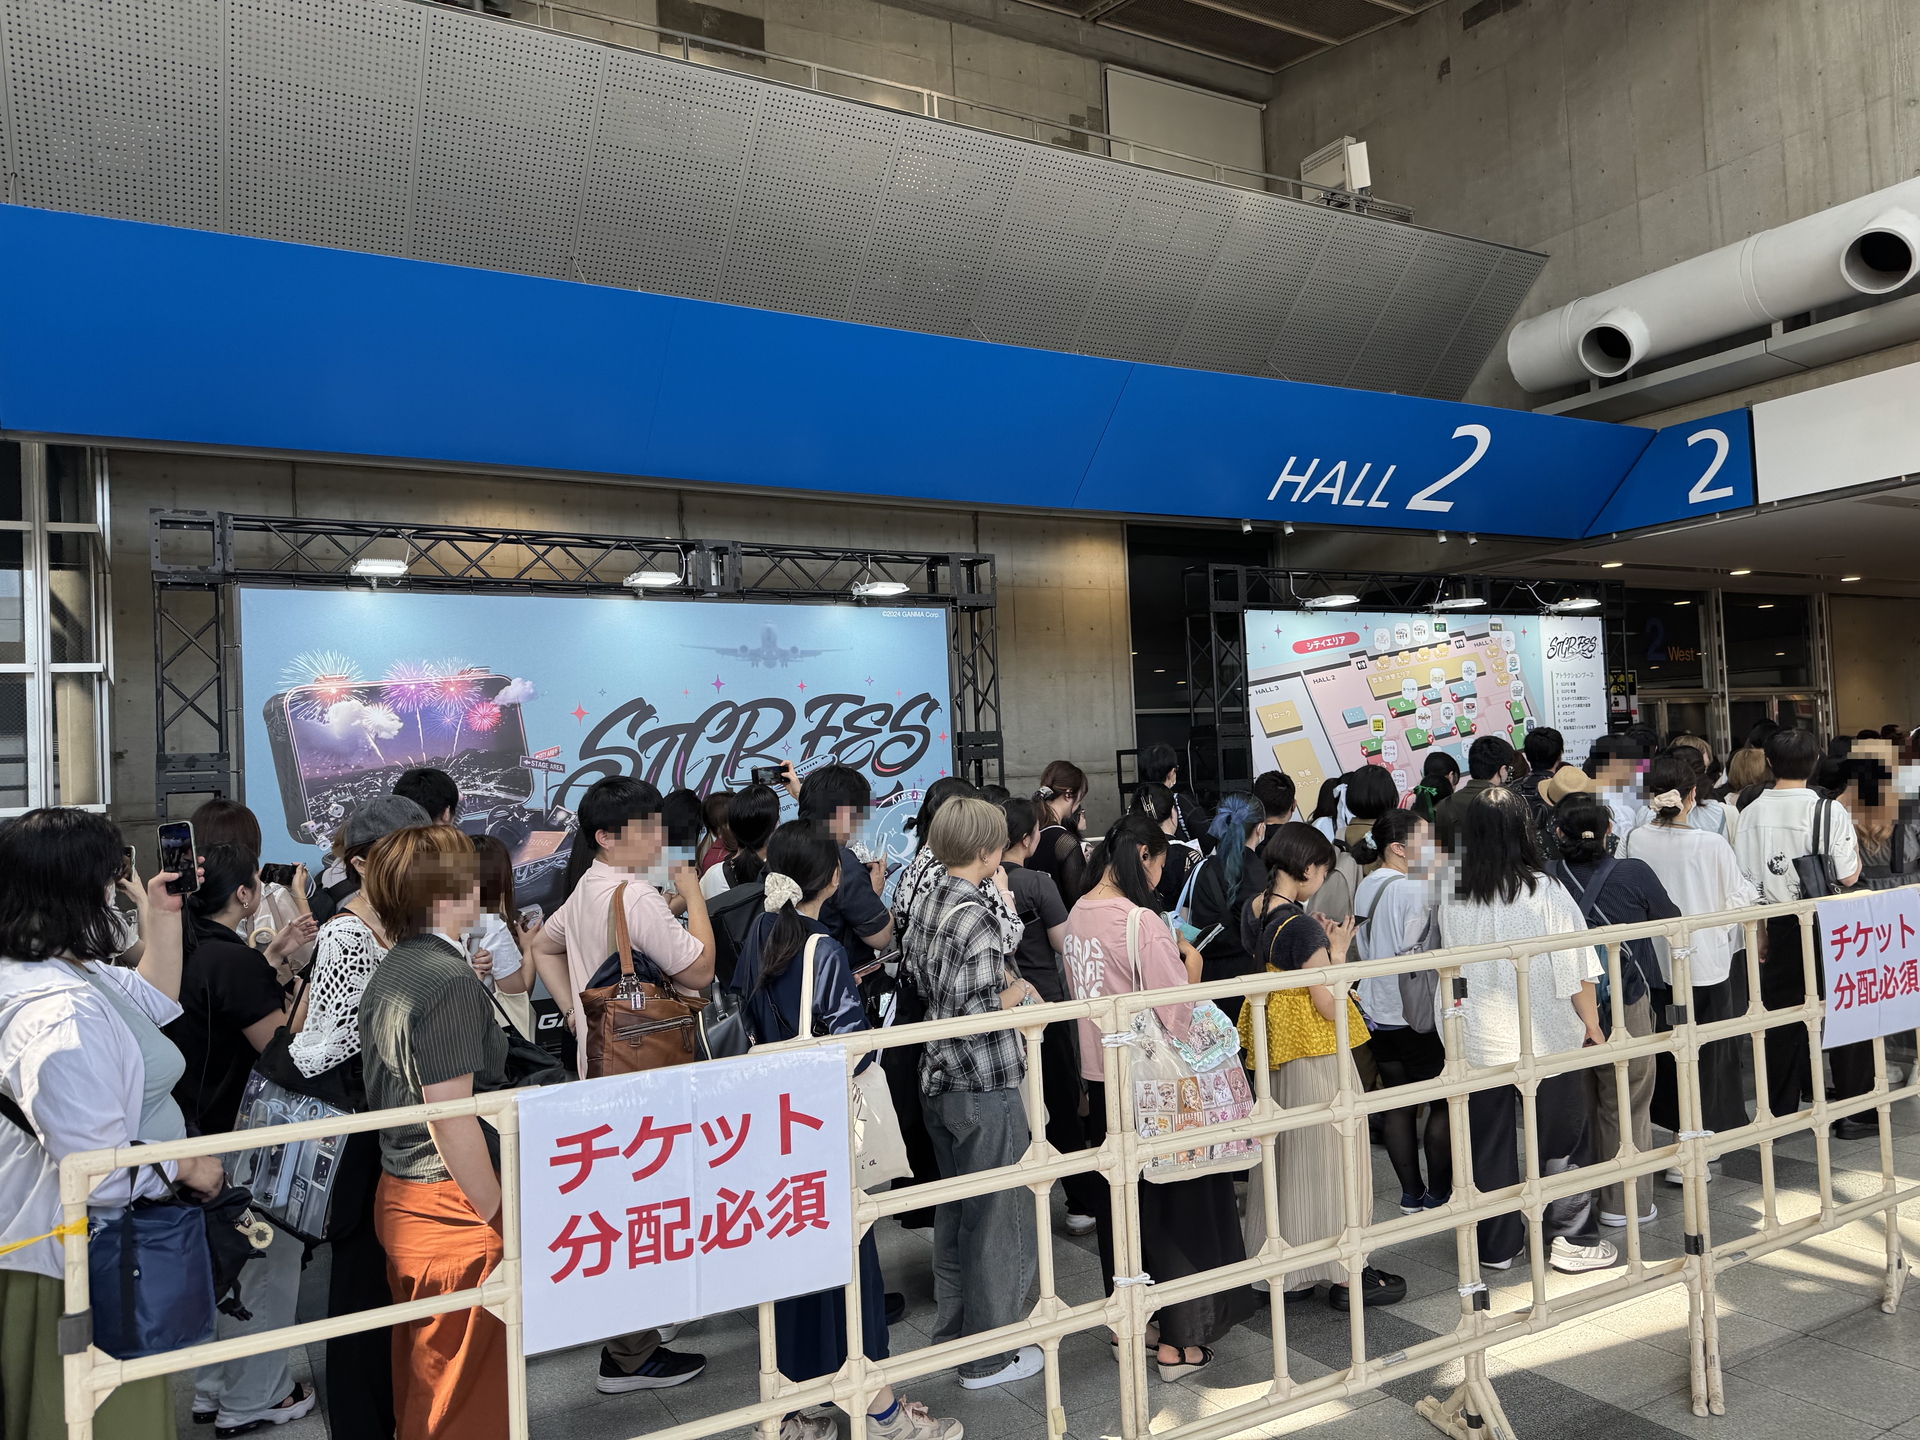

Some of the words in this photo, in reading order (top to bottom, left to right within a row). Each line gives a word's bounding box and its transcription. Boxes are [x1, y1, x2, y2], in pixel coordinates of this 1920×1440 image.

[1267, 456, 1397, 509] HALL
[1405, 424, 1492, 513] 2
[1686, 428, 1734, 504] 2
[881, 610, 900, 618] ©2024
[925, 611, 941, 619] Corp.
[1306, 635, 1346, 651] シティエリア
[1473, 640, 1489, 648] HALL
[1645, 617, 1666, 661] 2
[1667, 646, 1695, 661] West
[1312, 676, 1331, 685] HALL
[1331, 674, 1337, 682] 2
[1254, 686, 1275, 696] HALL
[1428, 691, 1437, 699] 12
[1267, 709, 1291, 721] クローク
[1461, 719, 1468, 727] 3
[1415, 732, 1423, 740] 5
[530, 760, 549, 769] STAGE
[549, 763, 564, 772] AREA
[1297, 777, 1321, 789] スペース
[1829, 913, 1916, 963] チケット
[1833, 958, 1920, 1012] 分配必須
[549, 1092, 825, 1196] チケット
[547, 1169, 831, 1285] 分配必須
